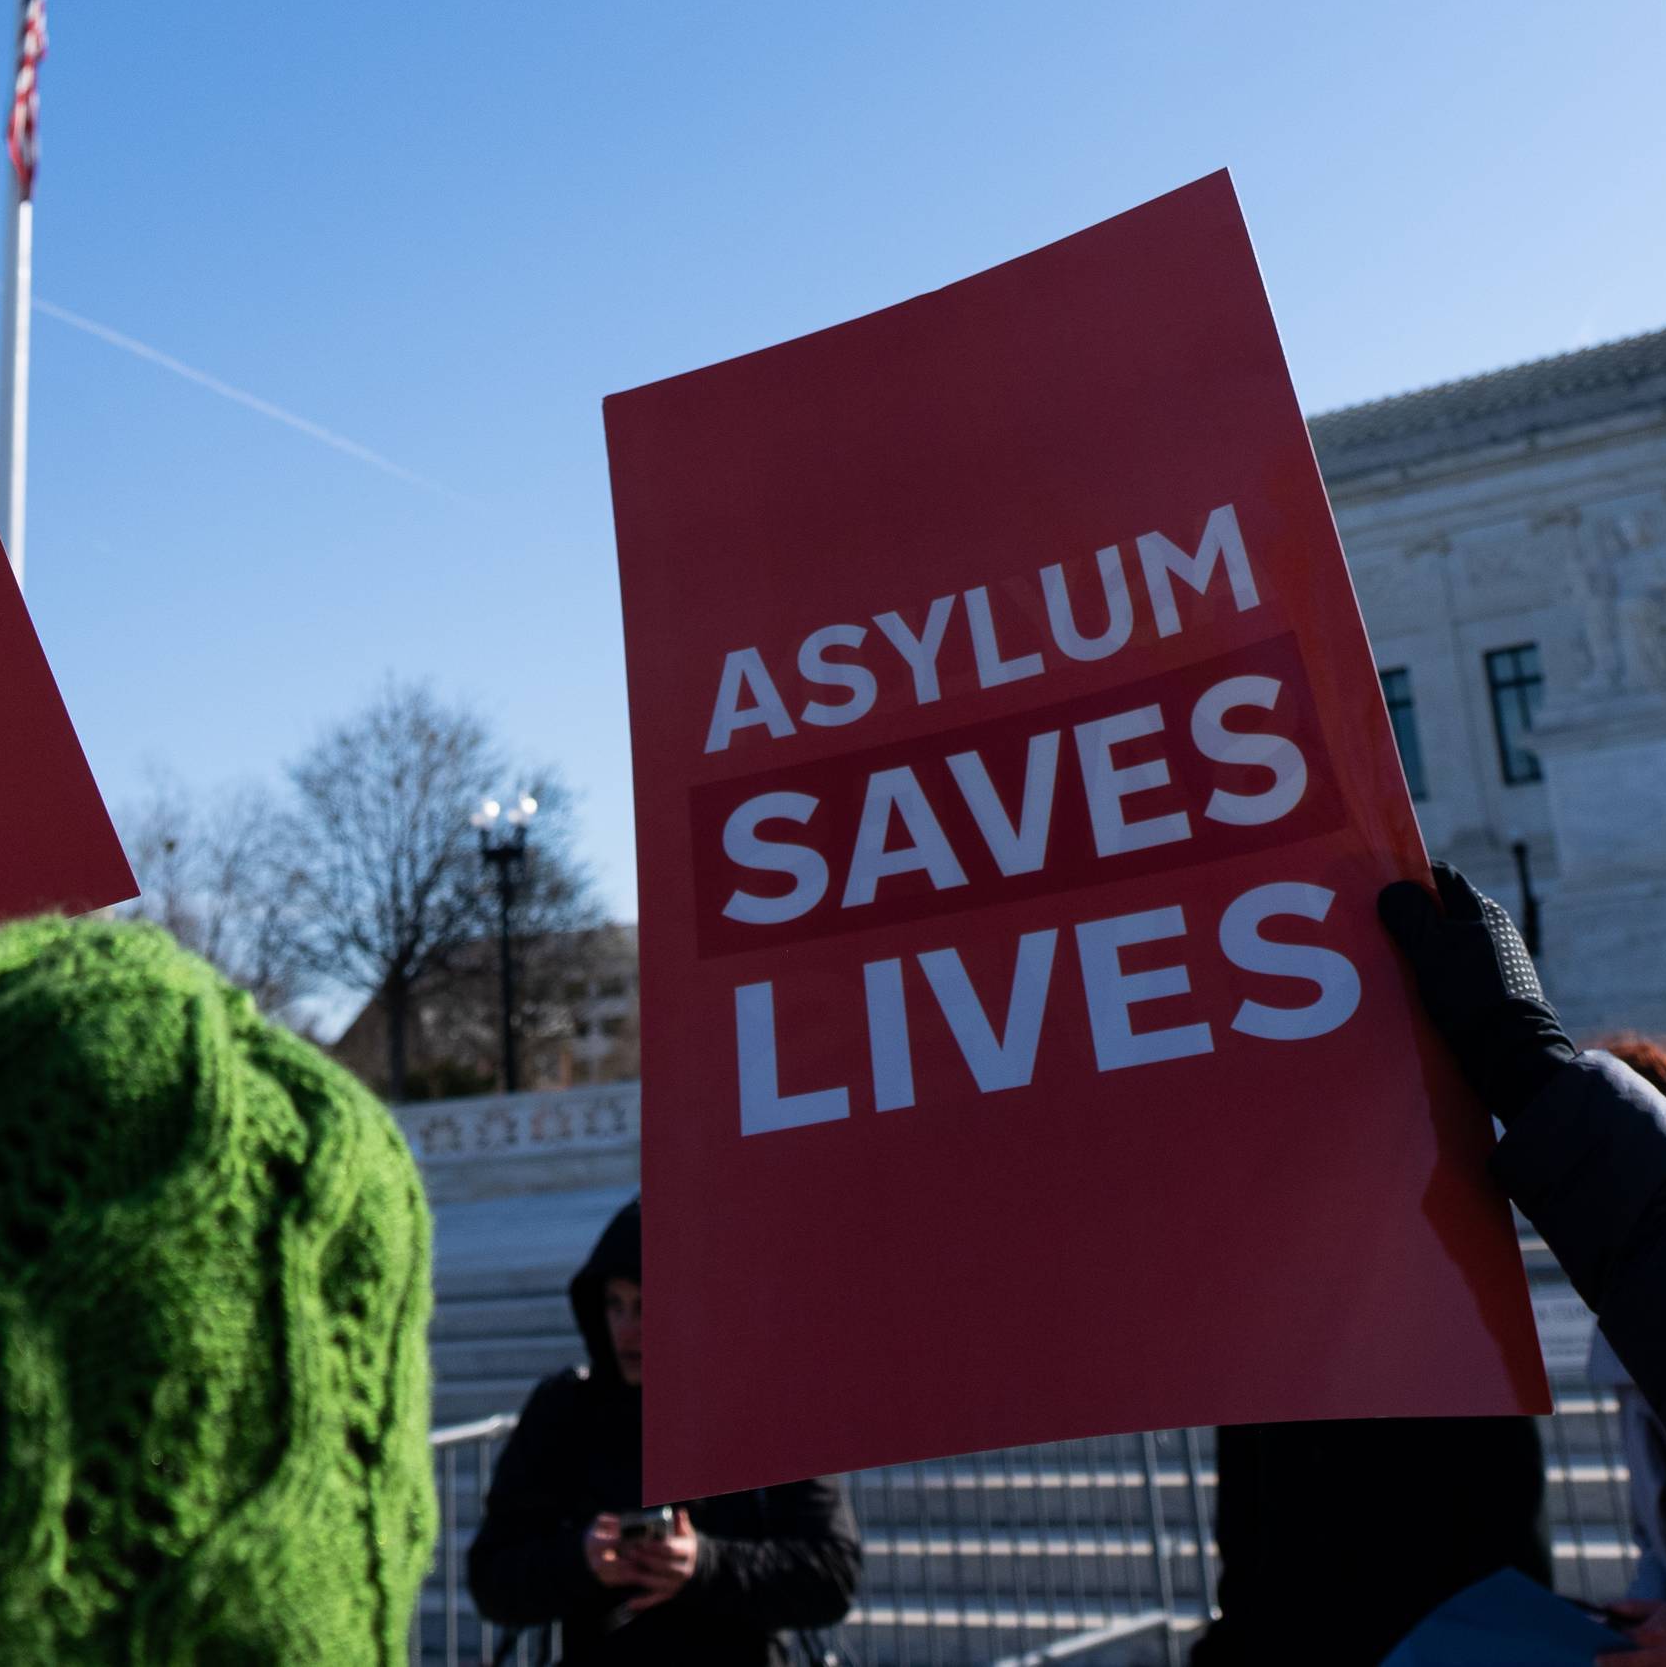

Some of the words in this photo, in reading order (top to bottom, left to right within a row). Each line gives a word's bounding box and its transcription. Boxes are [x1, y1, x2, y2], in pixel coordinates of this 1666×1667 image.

[704, 503, 1260, 754] ASYLUM
[722, 675, 1308, 924] SAVES
[735, 882, 1361, 1136] LIVES
